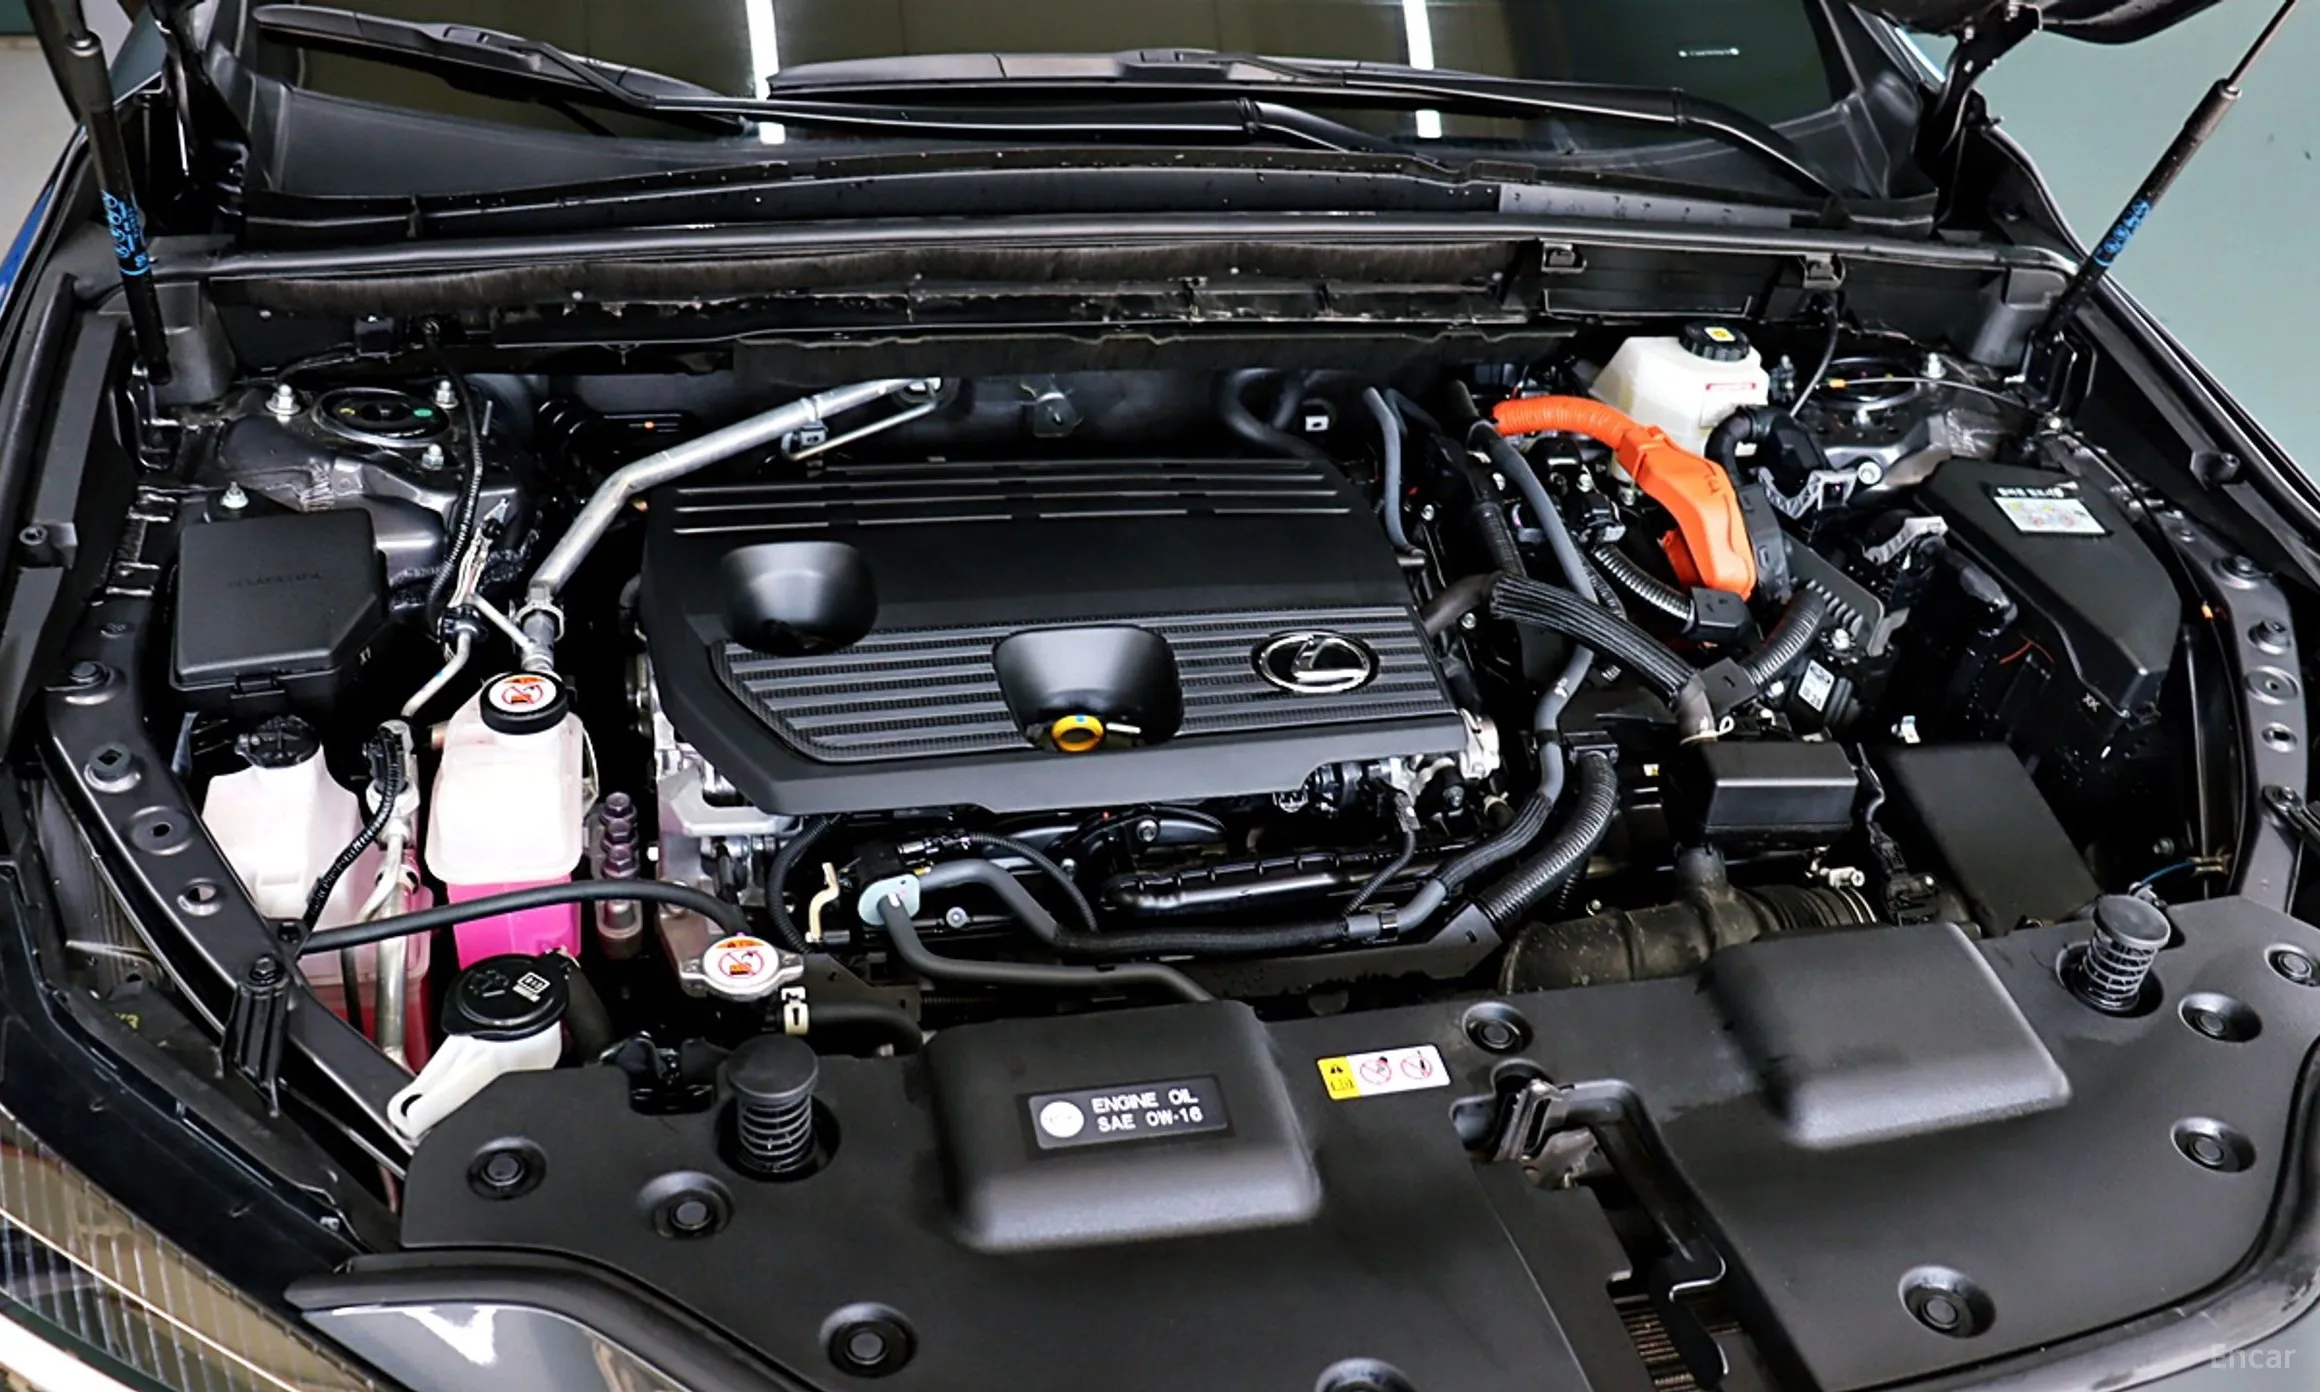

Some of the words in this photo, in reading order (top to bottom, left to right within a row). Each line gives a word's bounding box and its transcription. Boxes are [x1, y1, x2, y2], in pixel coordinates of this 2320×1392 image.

[1091, 1091, 1160, 1114] ENGINE
[1168, 1088, 1199, 1105] OIL
[1097, 1113, 1136, 1133] SAE
